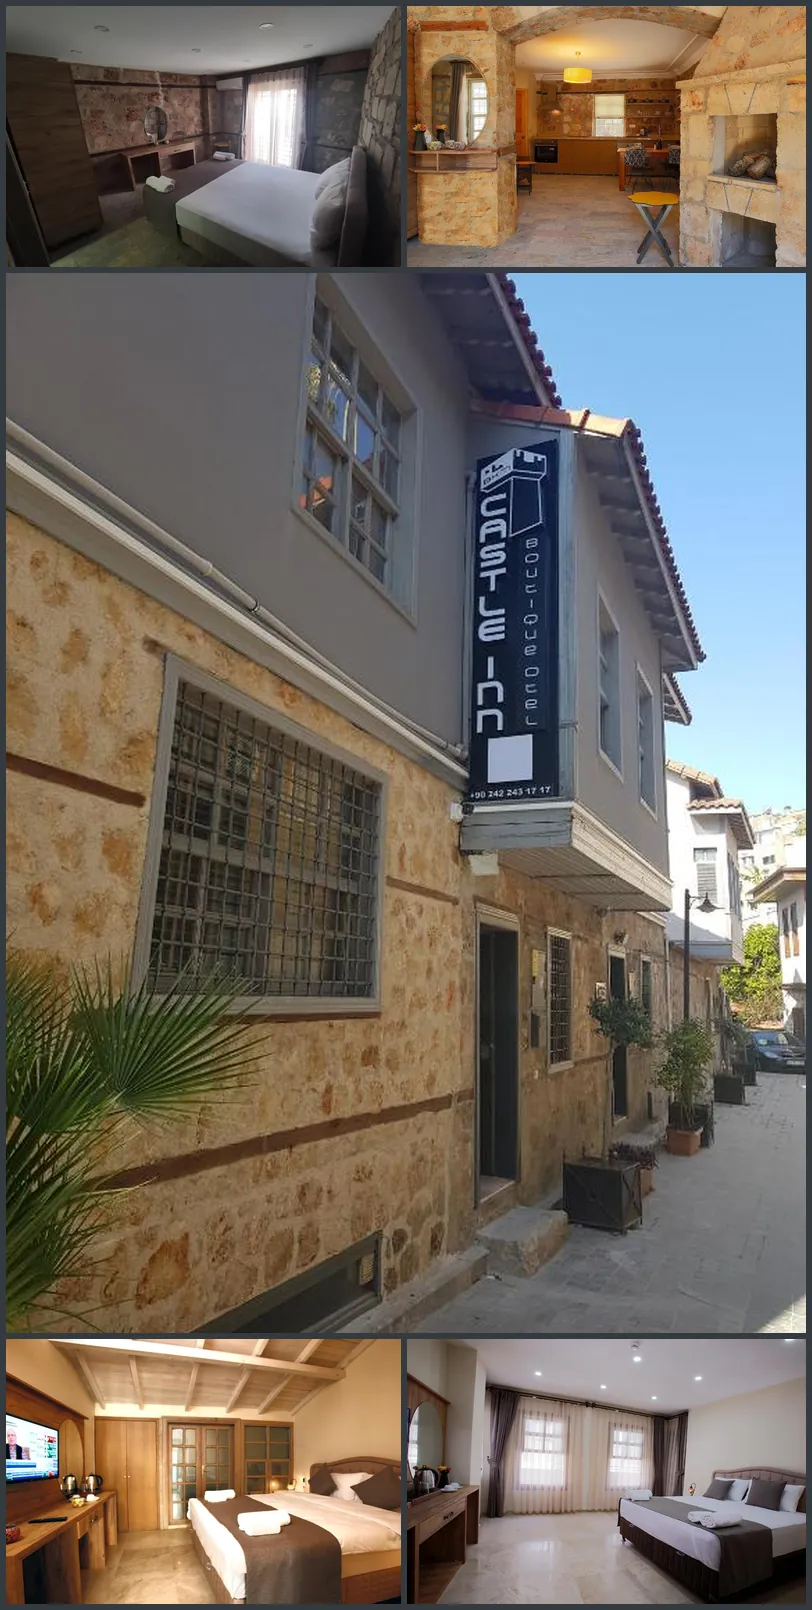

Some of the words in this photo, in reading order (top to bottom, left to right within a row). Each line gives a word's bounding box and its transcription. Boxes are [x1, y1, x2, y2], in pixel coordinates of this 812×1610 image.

[478, 492, 507, 642] CASTLE
[488, 790, 504, 798] 242
[507, 787, 523, 797] 243
[525, 787, 537, 795] 17
[540, 786, 551, 794] 17
